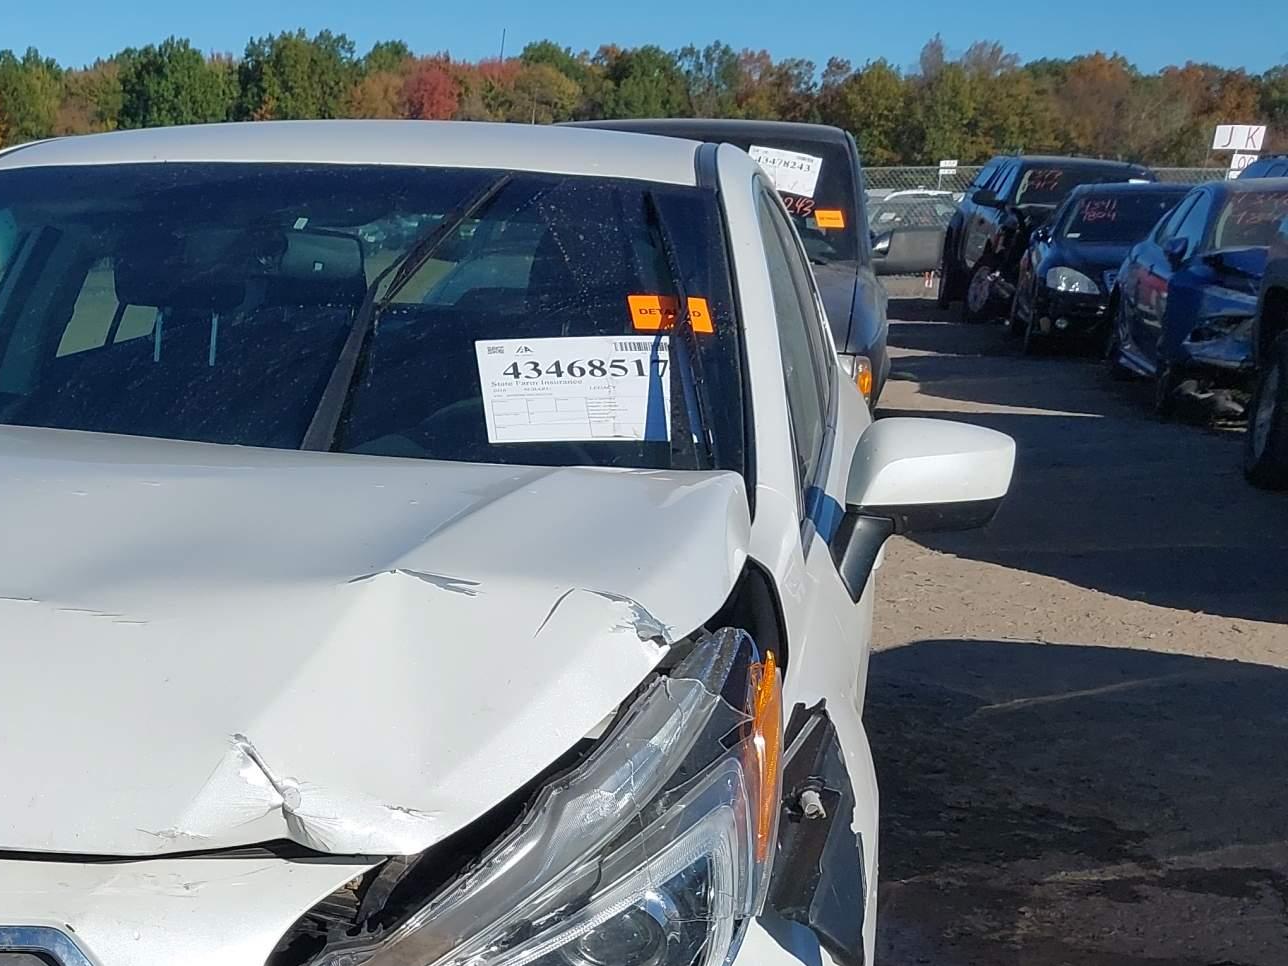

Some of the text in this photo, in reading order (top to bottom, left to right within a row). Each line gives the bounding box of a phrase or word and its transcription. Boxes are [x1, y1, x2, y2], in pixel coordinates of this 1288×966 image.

[1221, 126, 1260, 149] J K
[502, 358, 669, 380] 43468517
